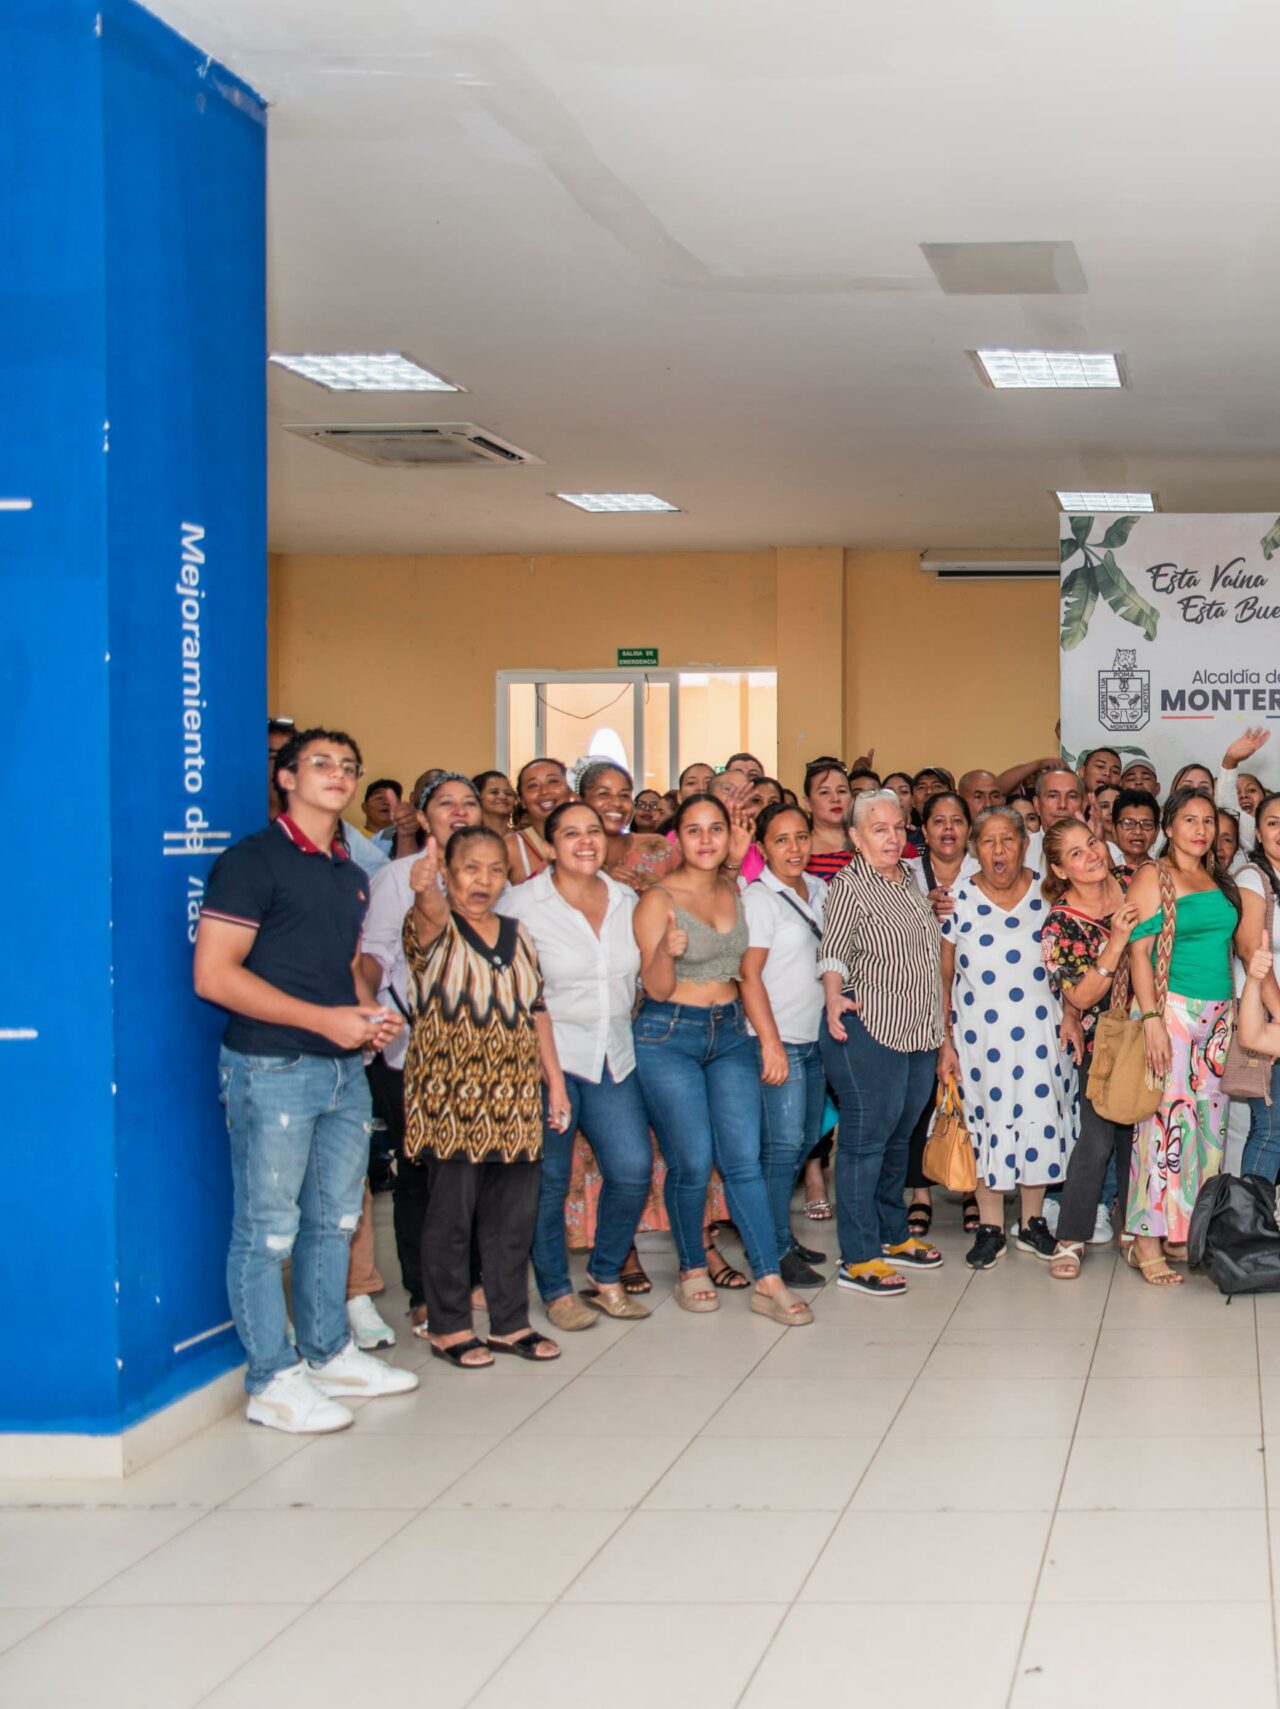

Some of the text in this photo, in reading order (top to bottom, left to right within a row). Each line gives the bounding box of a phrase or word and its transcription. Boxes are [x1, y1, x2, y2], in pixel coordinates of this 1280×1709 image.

[1146, 557, 1269, 595] Esta Vaina
[1177, 595, 1229, 624] Esta
[176, 521, 207, 794] Mejoramiento
[1192, 669, 1261, 685] Alcaldía
[185, 806, 209, 855] de
